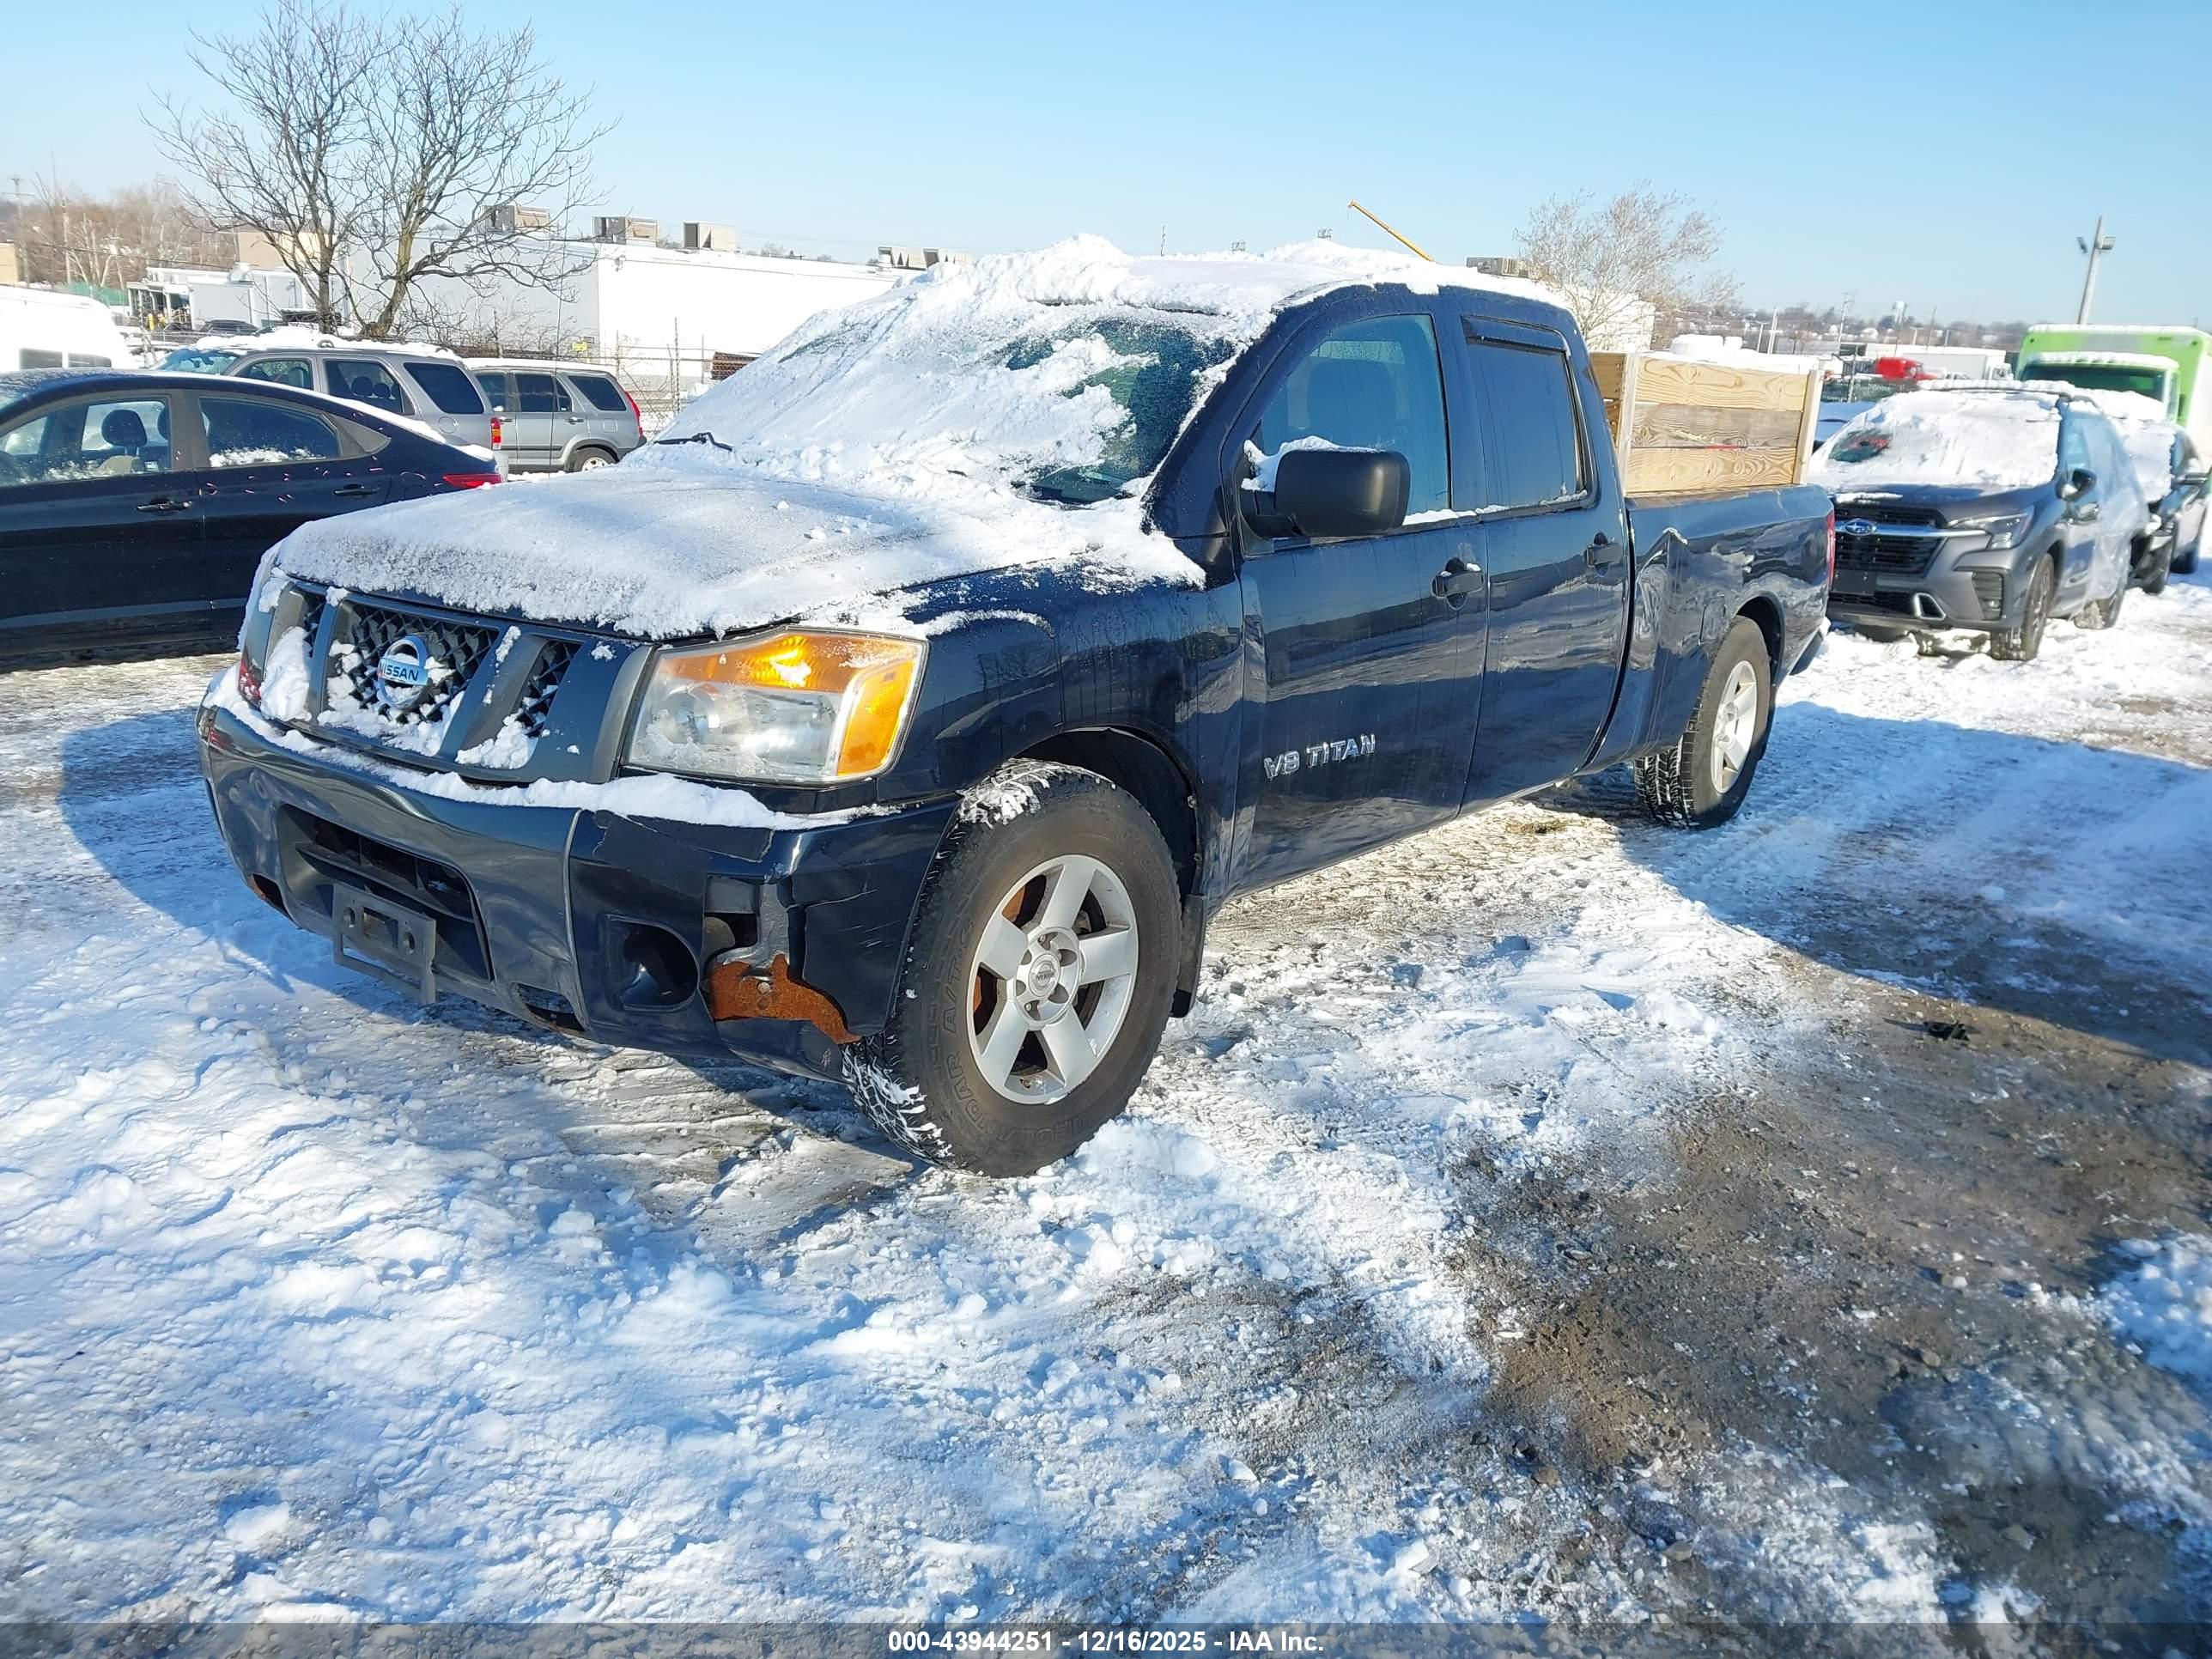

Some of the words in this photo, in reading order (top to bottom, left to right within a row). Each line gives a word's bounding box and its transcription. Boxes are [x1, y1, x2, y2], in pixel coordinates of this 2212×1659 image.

[378, 661, 419, 681] NISSAN
[1263, 750, 1300, 780] V8
[1306, 733, 1376, 769] TITAN
